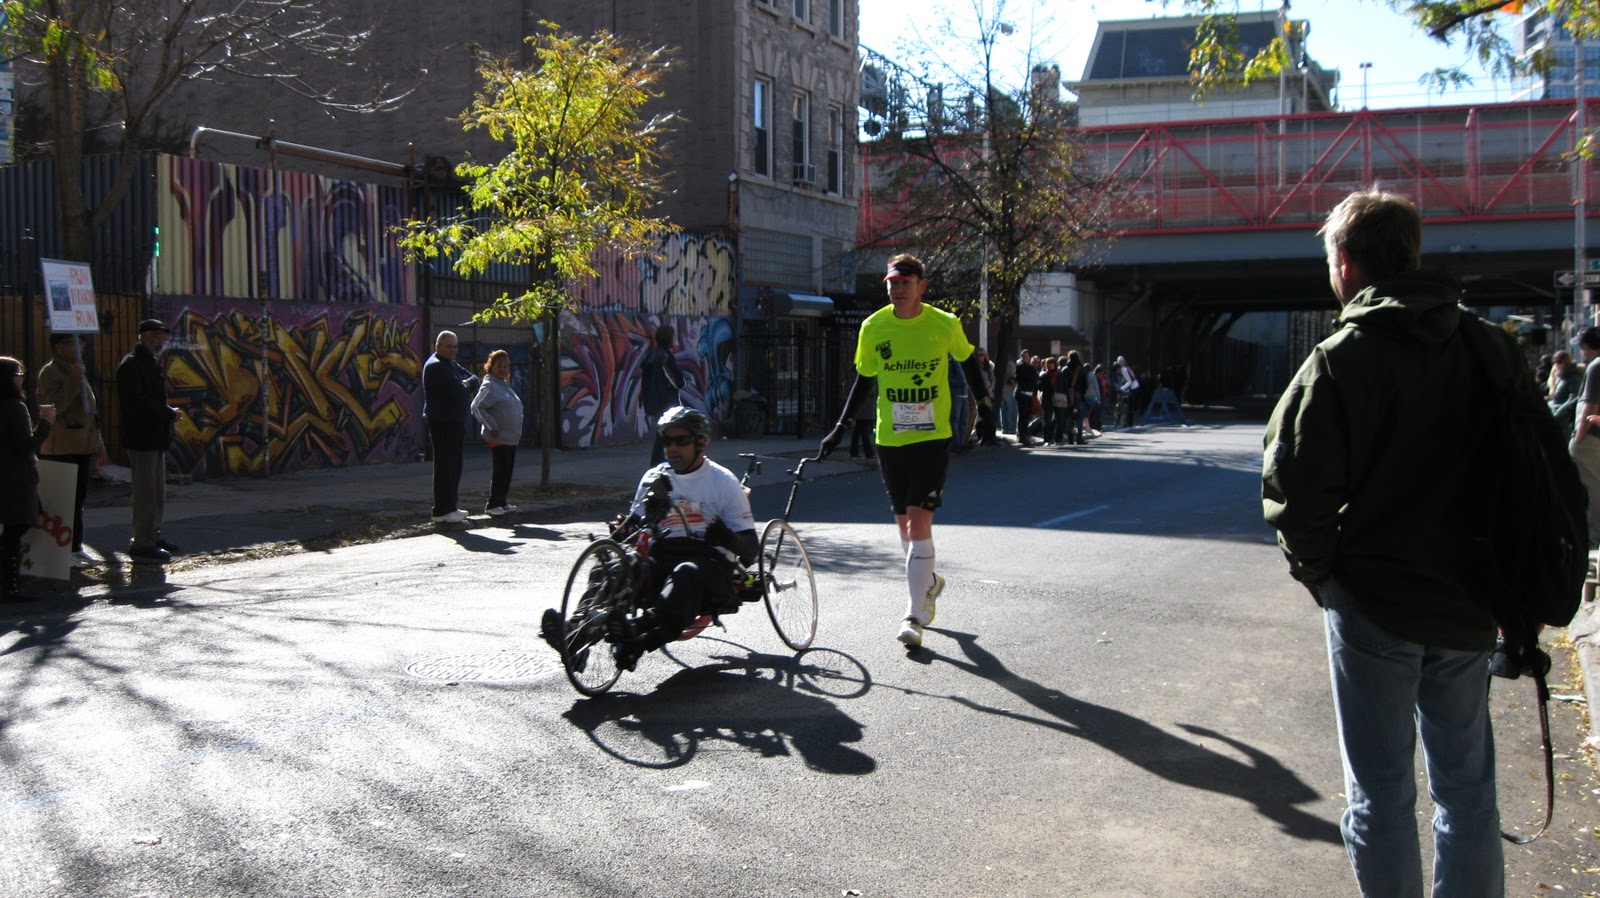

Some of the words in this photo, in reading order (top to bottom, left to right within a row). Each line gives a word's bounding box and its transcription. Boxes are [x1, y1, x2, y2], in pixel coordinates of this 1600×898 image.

[75, 310, 96, 327] RUN
[884, 360, 927, 371] Achilles
[886, 385, 938, 402] GUIDE
